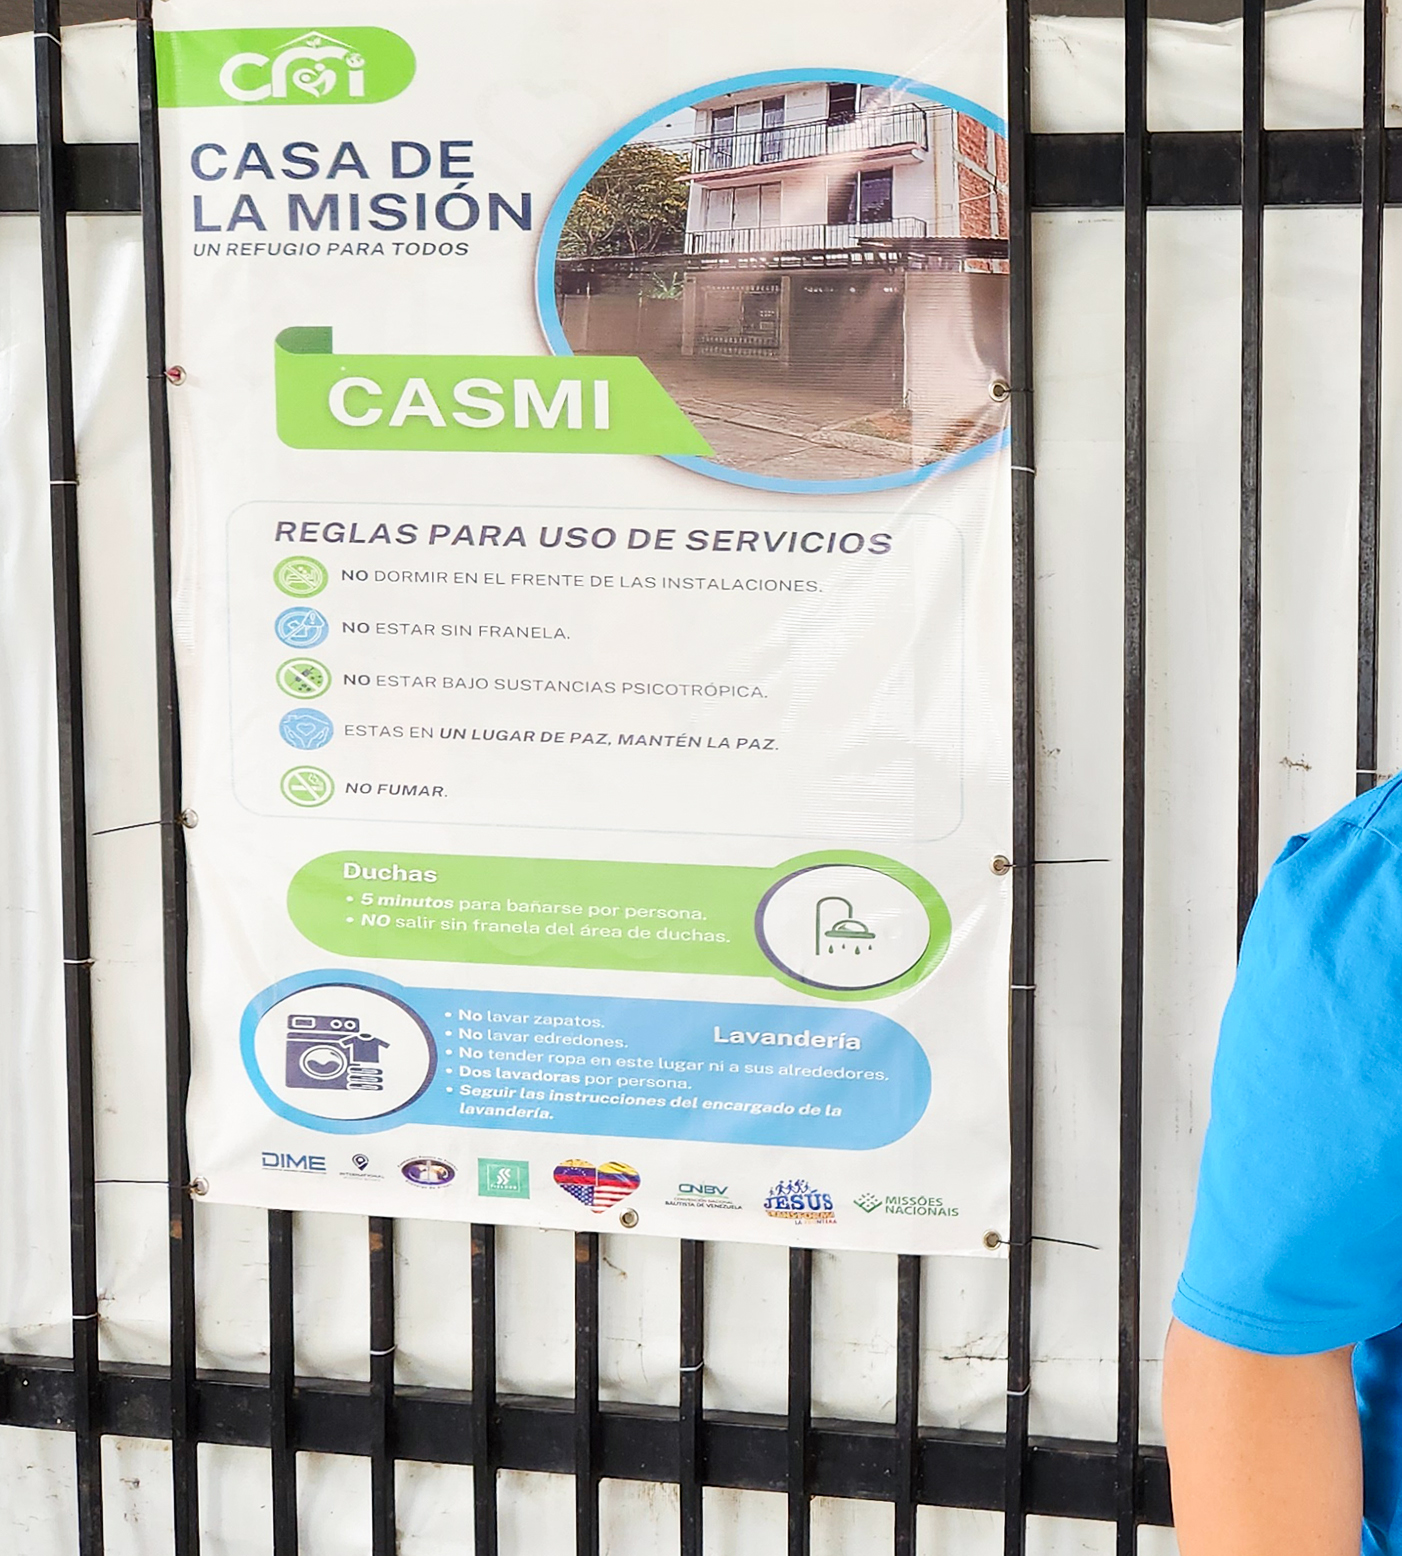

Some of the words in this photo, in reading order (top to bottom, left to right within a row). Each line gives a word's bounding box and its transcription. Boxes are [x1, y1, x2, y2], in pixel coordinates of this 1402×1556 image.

[190, 140, 371, 181] CASA
[391, 139, 475, 180] DE
[193, 193, 268, 233] LA
[288, 183, 532, 232] MISIÓN
[193, 243, 221, 257] UN
[225, 242, 321, 257] REFUGIO
[326, 242, 389, 256] PARA
[393, 242, 469, 256] TODOS
[328, 377, 609, 430] CASMI
[274, 521, 419, 544] REGLAS
[428, 524, 528, 547] PARA
[539, 527, 617, 549] USO
[627, 528, 676, 550] DE
[685, 530, 893, 555] SERVICIOS
[342, 569, 369, 582] NO
[374, 570, 448, 584] DORMIR
[454, 572, 479, 584] EN
[484, 573, 506, 585] EL
[511, 573, 585, 587] FRENTE
[590, 575, 614, 588] DE
[620, 576, 657, 589] LAS
[662, 577, 823, 593] INSTALACIONES.
[342, 622, 370, 634] NO
[376, 623, 436, 636] ESTAR
[441, 624, 473, 637] SIN
[478, 625, 570, 639] FRANELA.
[343, 674, 371, 686] NO
[376, 675, 437, 688] ESTAR
[443, 677, 489, 690] BAJO
[494, 678, 617, 694] SUSTANCIAS
[622, 681, 768, 699] PSICOTRÓPICA.
[344, 724, 404, 738] ESTAS
[410, 727, 434, 739] EN
[439, 727, 468, 740] UN
[472, 729, 535, 743] LUGAR
[540, 731, 566, 744] DE
[569, 732, 612, 746] PAZ,
[617, 732, 702, 748] MANTÉN
[707, 736, 731, 749] LA
[736, 737, 779, 751] PAZ.
[345, 782, 372, 794] NO
[377, 783, 449, 798] FUMAR.
[343, 861, 438, 883] Duchas
[361, 892, 374, 906] 5
[377, 893, 454, 910] minutos
[459, 898, 501, 914] para
[507, 898, 583, 916] bañarse
[588, 904, 620, 921] por
[625, 906, 707, 923] persona.
[361, 913, 391, 928] NO
[395, 914, 435, 930] salir
[440, 916, 467, 931] sin
[473, 917, 540, 935] franela
[545, 920, 574, 936] del
[580, 923, 622, 939] área
[627, 924, 650, 940] de
[656, 925, 730, 943] duchas.
[458, 1008, 483, 1022] No
[487, 1010, 530, 1025] lavar
[534, 1013, 605, 1030] zapatos.
[459, 1027, 483, 1041] No
[487, 1028, 530, 1043] lavar
[534, 1031, 629, 1049] edredones.
[713, 1026, 862, 1051] Lavandería
[459, 1046, 483, 1060] No
[488, 1048, 544, 1064] tender
[548, 1053, 586, 1069] ropa
[591, 1055, 612, 1068] en
[616, 1056, 654, 1070] este
[658, 1056, 704, 1075] lugar
[709, 1060, 724, 1073] ni
[729, 1062, 740, 1074] a
[744, 1062, 774, 1075] sus
[779, 1062, 889, 1081] alrededores.
[459, 1065, 492, 1079] Dos
[495, 1066, 580, 1084] lavadoras
[584, 1073, 613, 1088] por
[618, 1075, 692, 1090] persona.
[459, 1084, 517, 1101] Seguir
[520, 1086, 545, 1101] las
[549, 1088, 667, 1108] instrucciones
[670, 1094, 698, 1109] del
[702, 1097, 794, 1117] encargado
[798, 1100, 821, 1115] de
[825, 1102, 843, 1117] la
[460, 1103, 554, 1121] lavandería.
[262, 1152, 326, 1171] DIME
[678, 1183, 729, 1195] CNBV
[764, 1189, 834, 1210] JESÚS
[885, 1196, 943, 1206] MISSÕES
[885, 1205, 959, 1217] NACIONAIS
